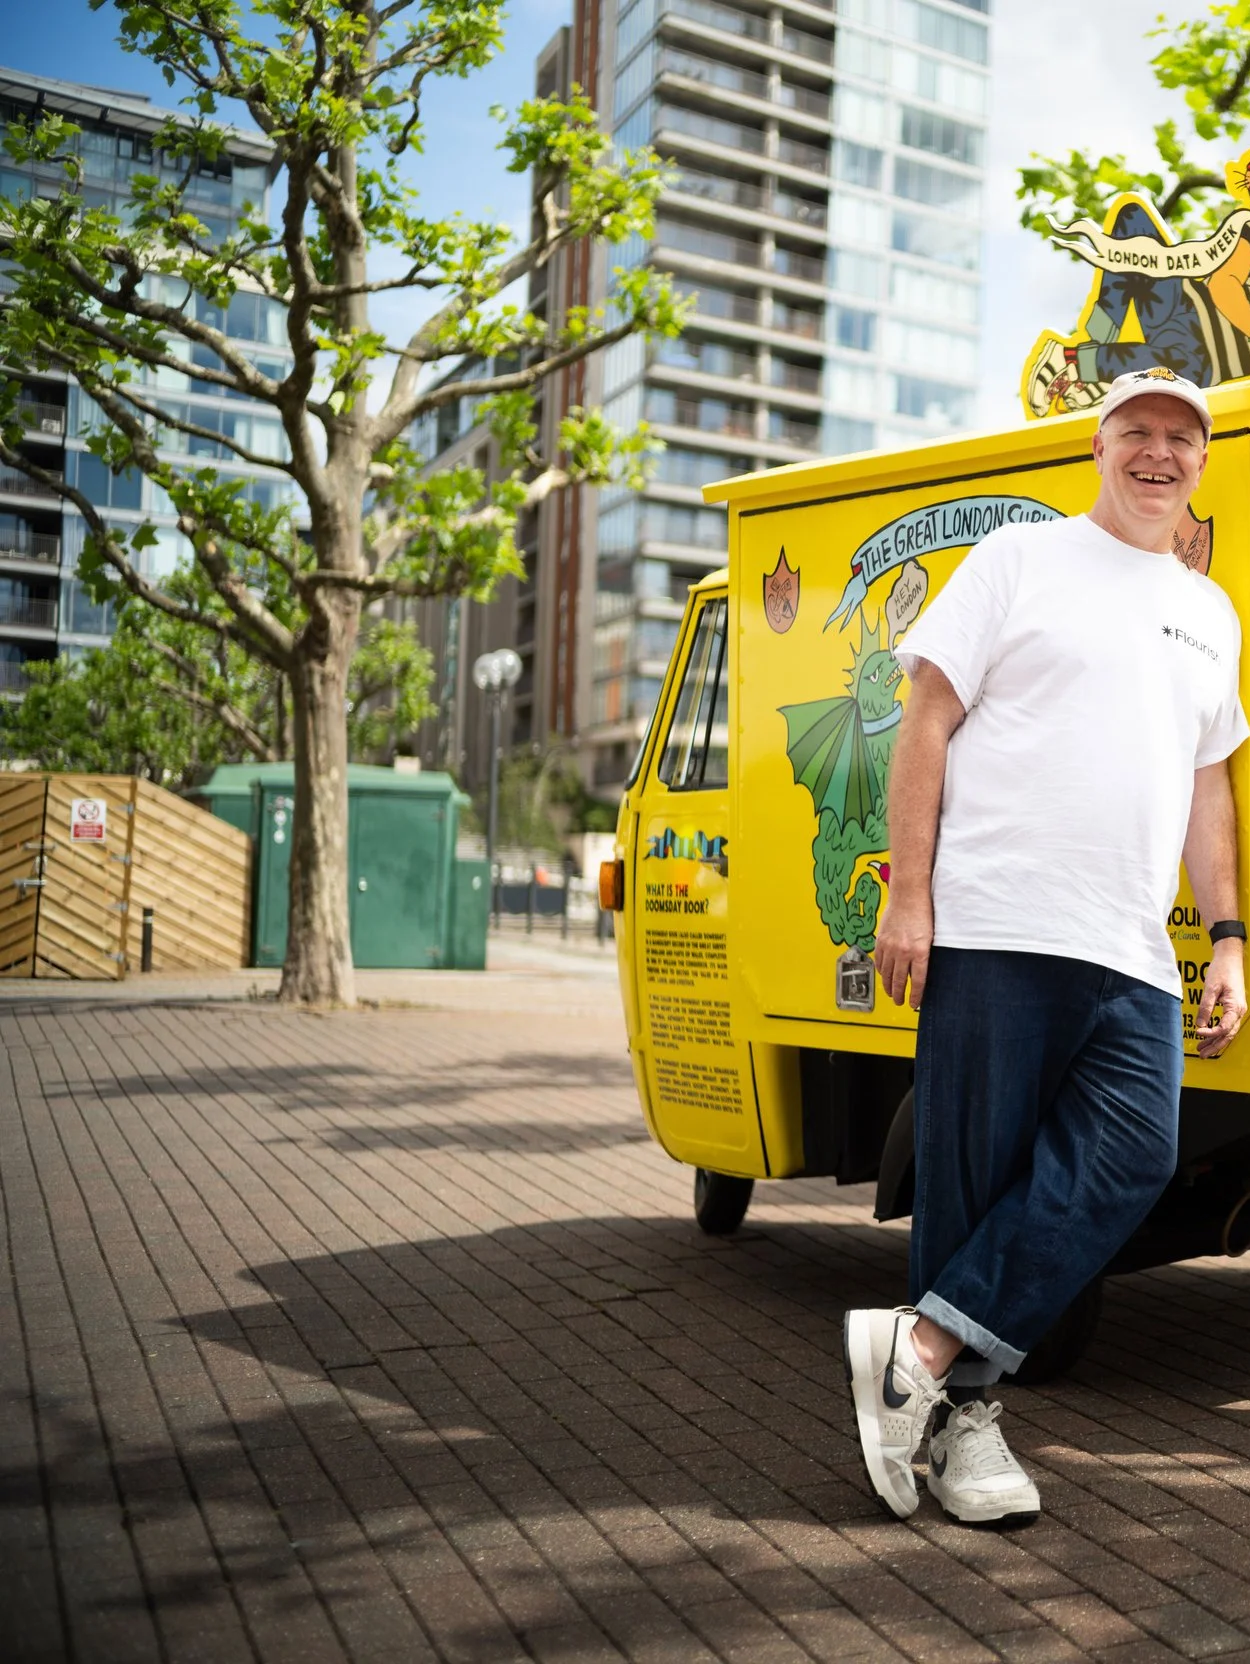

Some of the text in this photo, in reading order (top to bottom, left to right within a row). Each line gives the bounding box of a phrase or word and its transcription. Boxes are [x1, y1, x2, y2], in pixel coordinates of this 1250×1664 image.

[1108, 225, 1238, 271] LONDON DATA WEEK
[860, 538, 891, 577] THE
[894, 508, 940, 556] GREAT
[943, 503, 1005, 540] LONDON
[894, 578, 912, 605] HEY
[896, 581, 922, 619] LONDON
[645, 883, 689, 897] WHAT IS THE
[645, 898, 709, 914] DOOMSDAY BOOK?
[1170, 930, 1200, 941] of Canva
